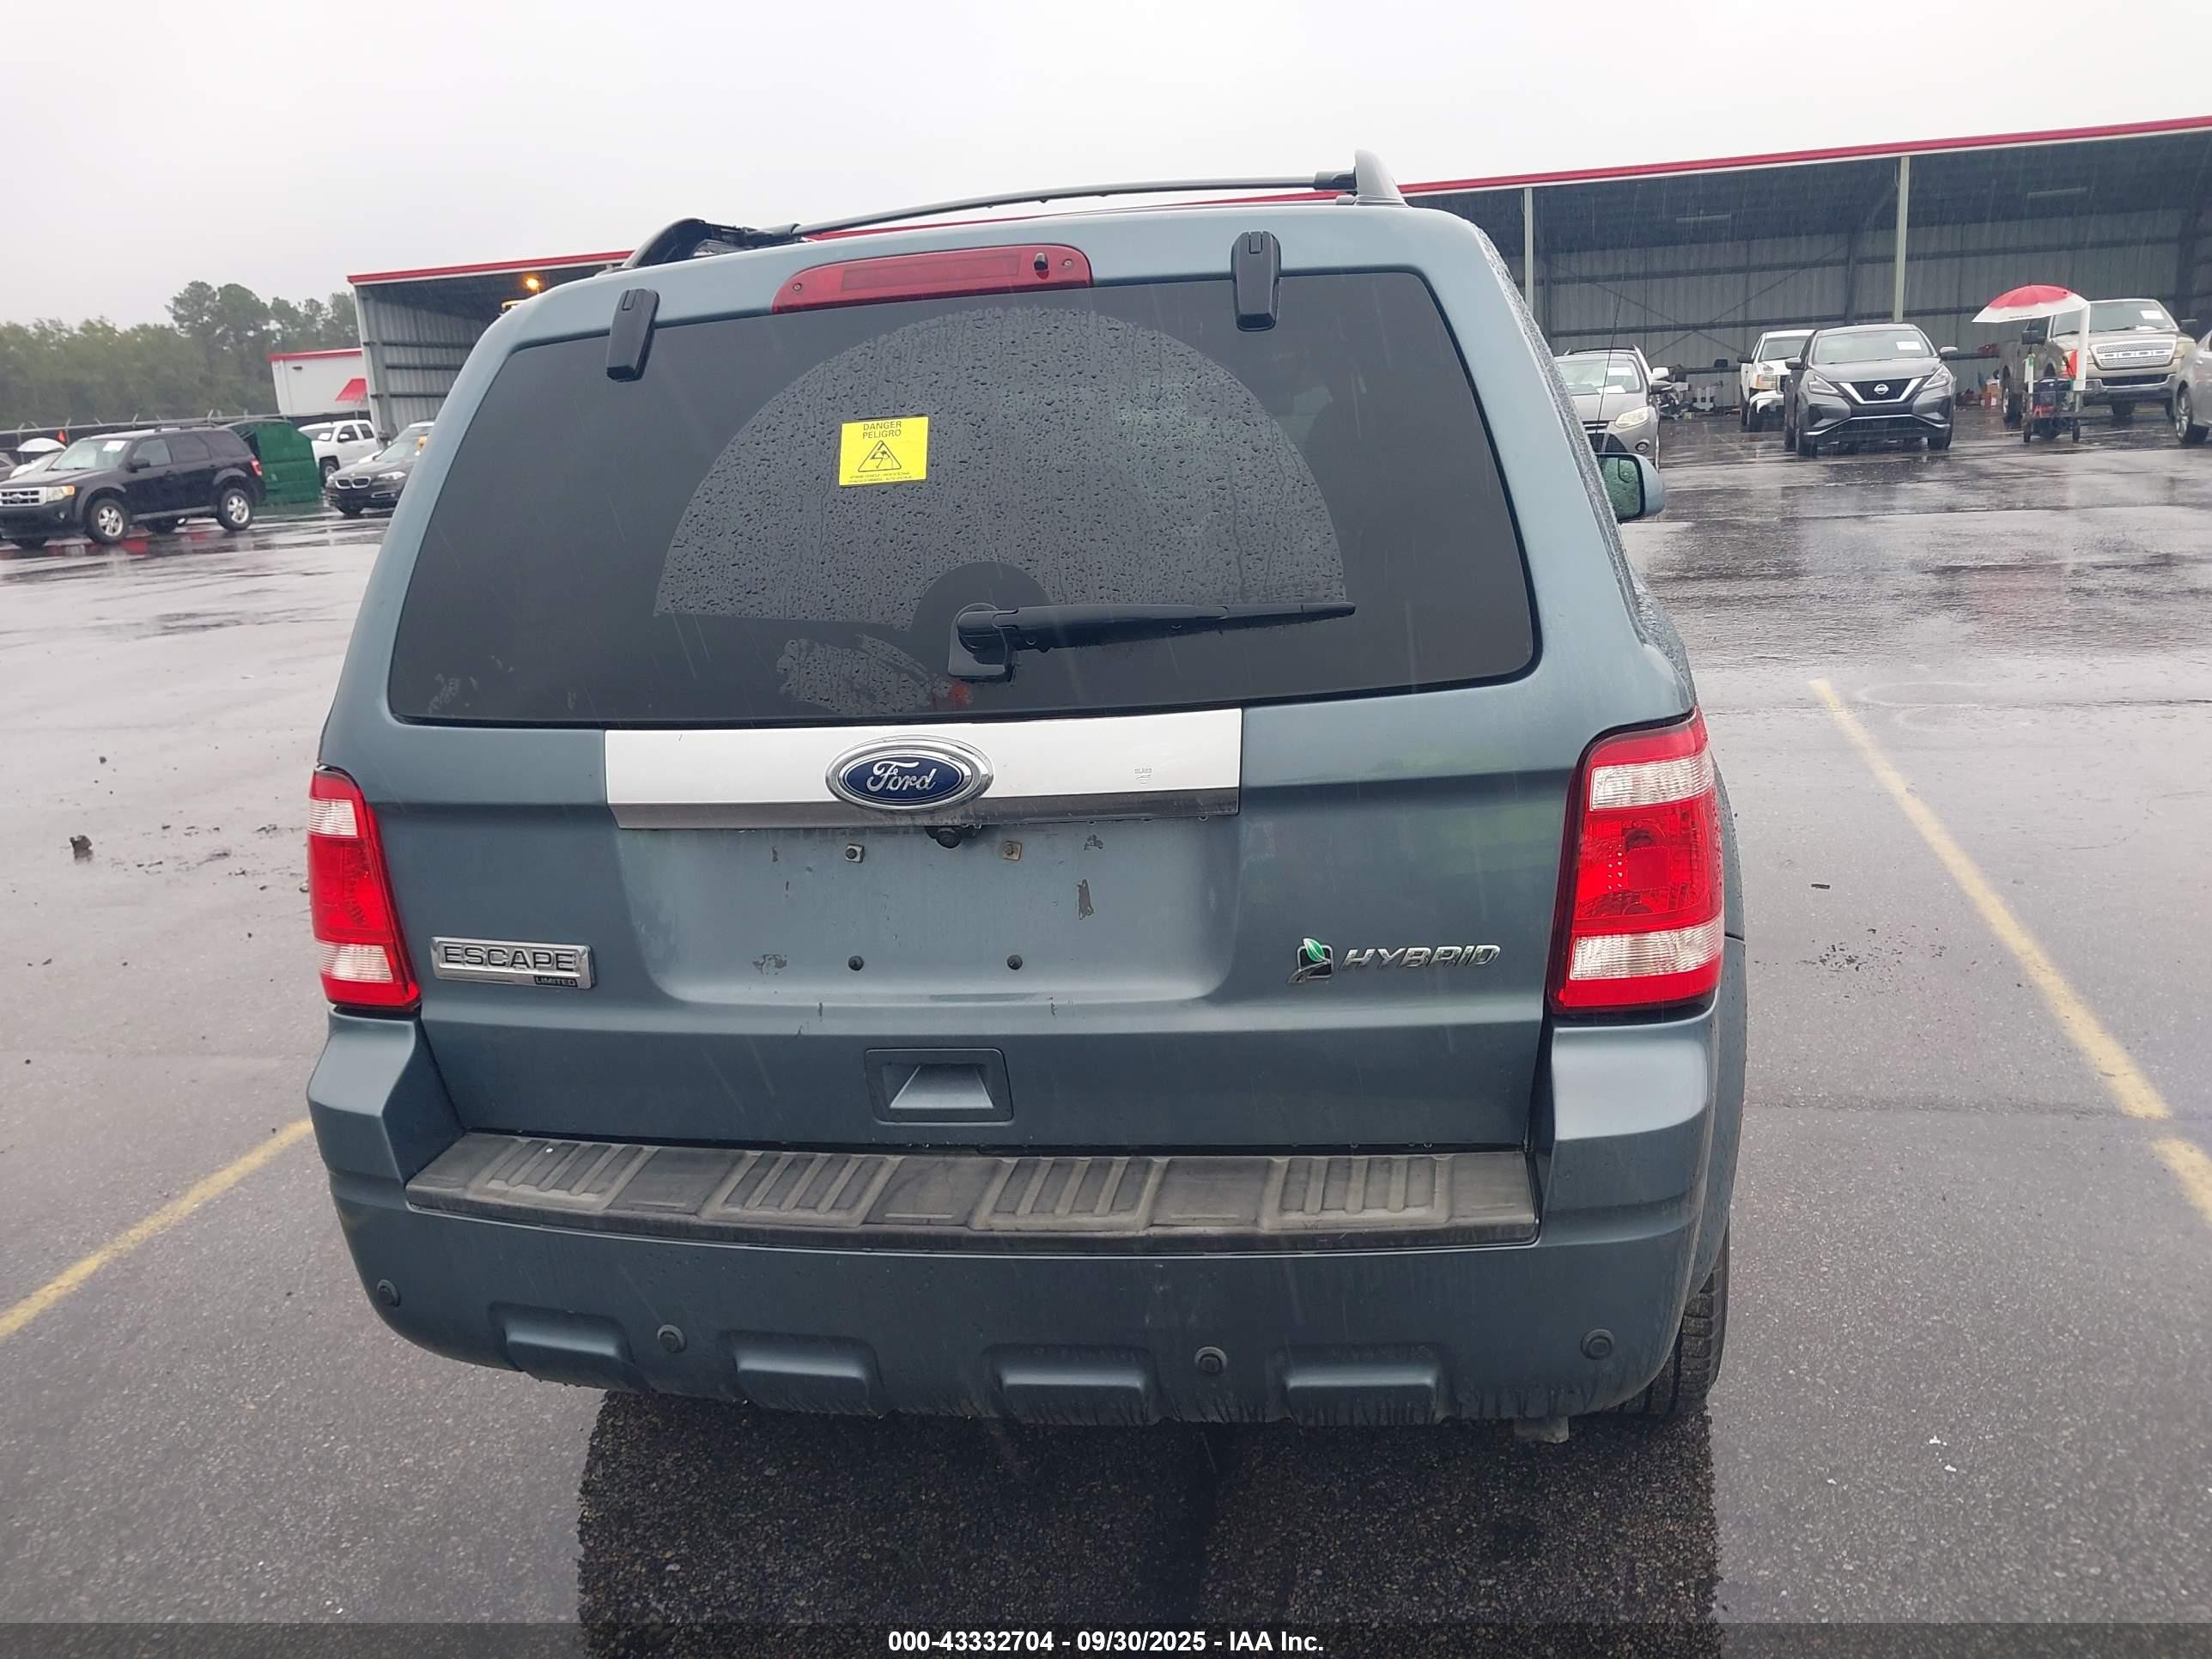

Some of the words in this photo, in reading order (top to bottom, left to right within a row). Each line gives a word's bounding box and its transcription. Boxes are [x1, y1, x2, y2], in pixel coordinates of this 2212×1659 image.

[862, 429, 902, 439] PELIGRO
[863, 421, 902, 430] DANGER
[866, 760, 937, 792] Ford
[442, 944, 580, 972] ESCAPE
[1339, 944, 1501, 971] HYBRID
[535, 976, 578, 987] LIMITED
